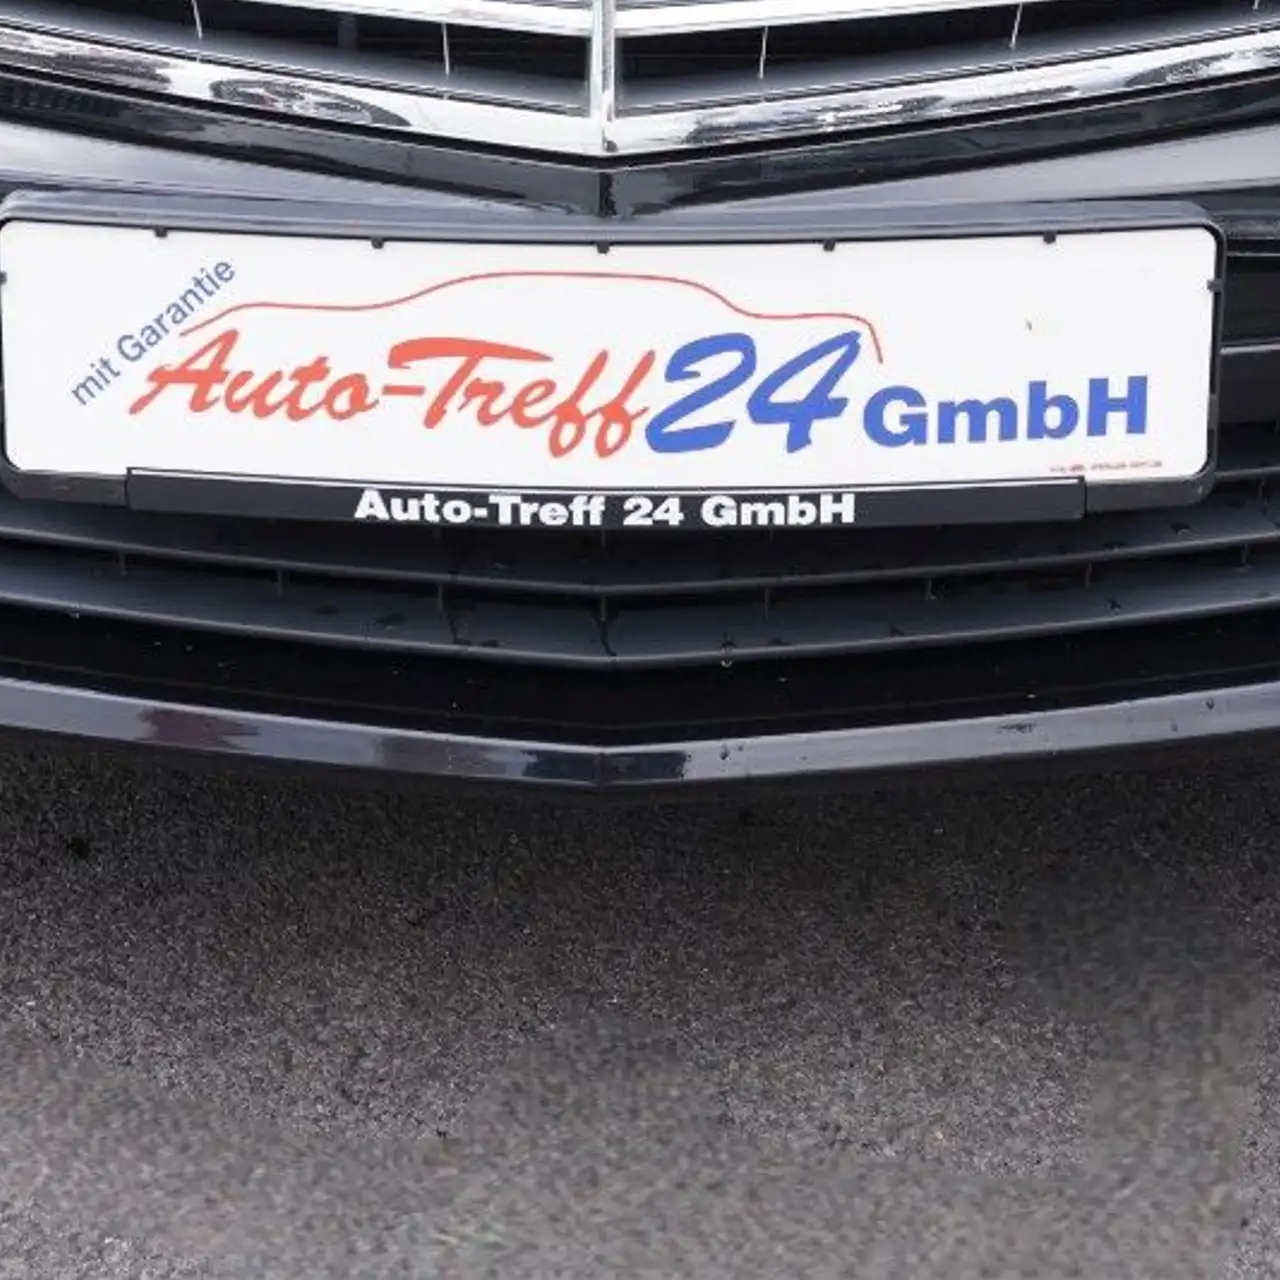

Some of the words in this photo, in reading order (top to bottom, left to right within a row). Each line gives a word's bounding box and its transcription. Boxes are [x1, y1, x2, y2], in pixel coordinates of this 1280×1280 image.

[70, 357, 121, 406] mit
[116, 260, 237, 364] Garantie
[645, 330, 862, 454] 24
[863, 375, 1149, 448] GmbH
[354, 488, 606, 526] Auto-Treff
[622, 495, 685, 527] 24
[700, 492, 857, 527] GmbH
